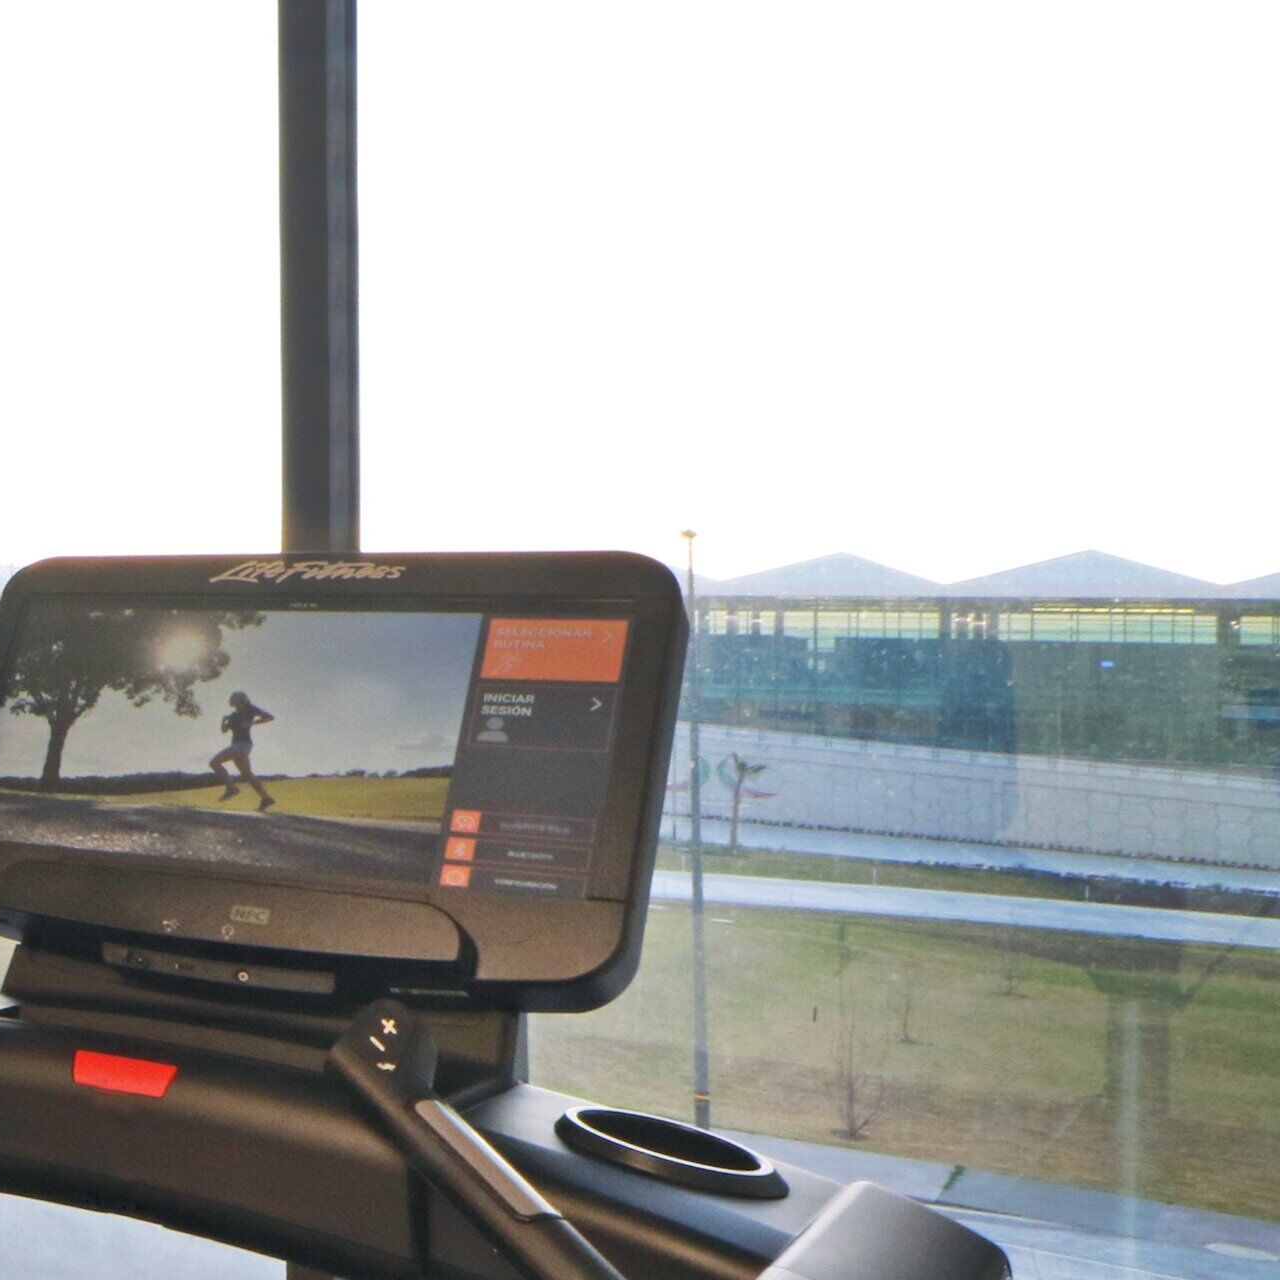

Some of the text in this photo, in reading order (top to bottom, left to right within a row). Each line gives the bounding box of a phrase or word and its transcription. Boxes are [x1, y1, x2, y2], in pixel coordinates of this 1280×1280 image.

[209, 560, 407, 584] Life Fitness
[495, 627, 592, 638] SELECCIONAR
[493, 640, 546, 649] RUTINA
[483, 692, 535, 704] INICIAR
[481, 704, 532, 716] SESIÓN
